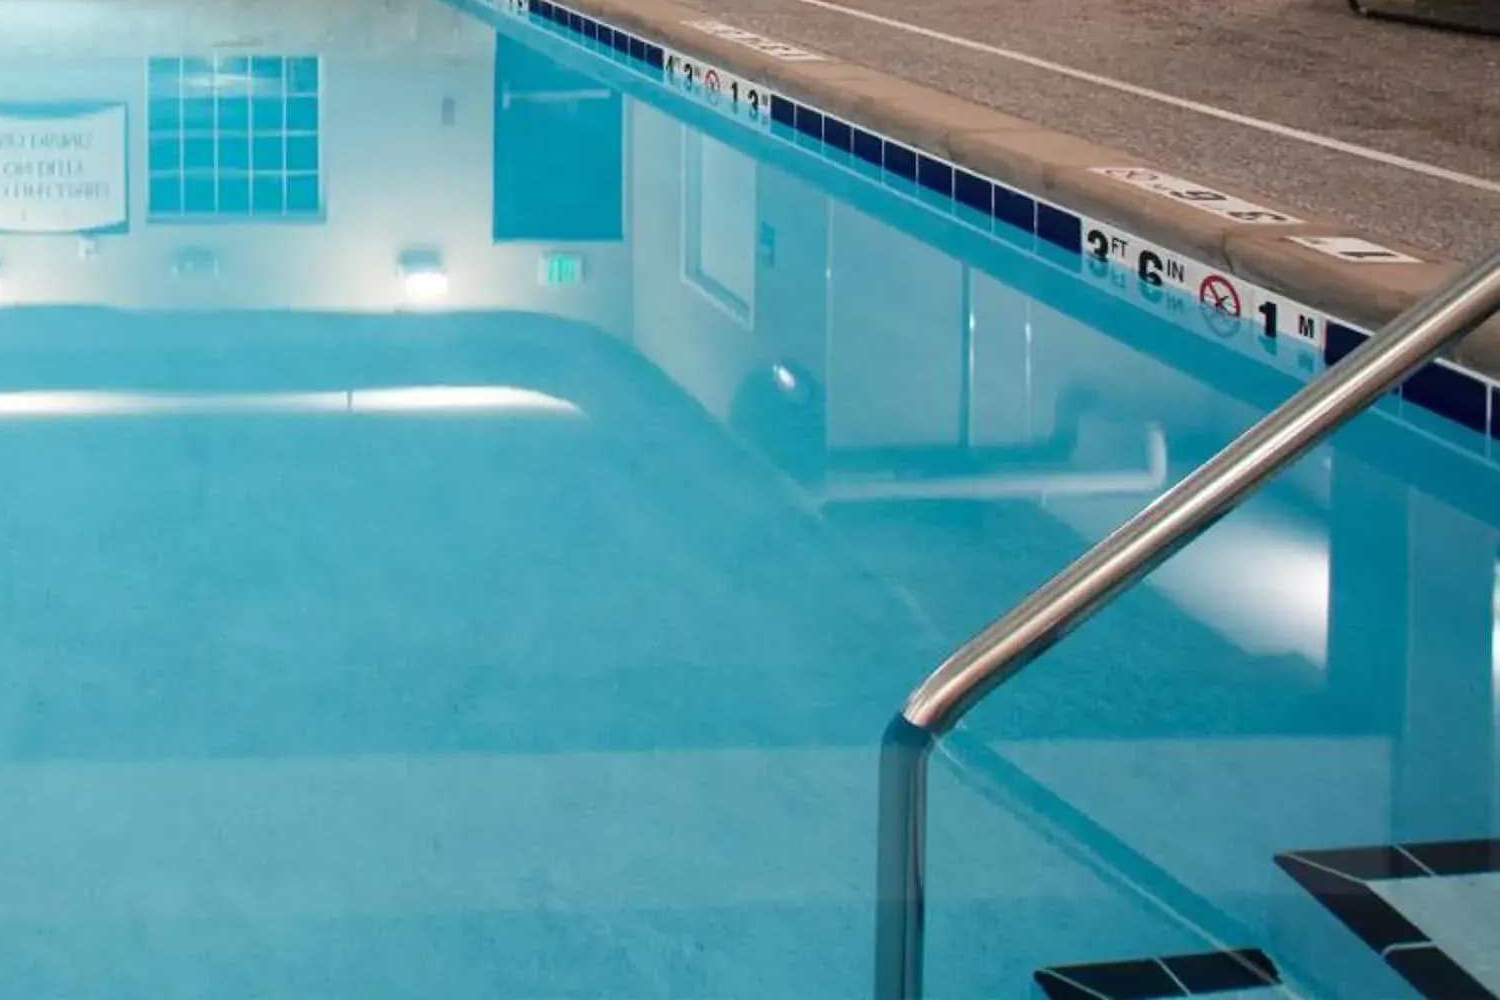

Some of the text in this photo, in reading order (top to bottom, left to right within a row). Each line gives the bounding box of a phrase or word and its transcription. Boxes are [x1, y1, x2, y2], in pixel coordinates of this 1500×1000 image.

[1087, 229, 1109, 263] 3
[1111, 237, 1129, 258] FT
[1138, 250, 1164, 286] 6
[1166, 259, 1185, 283] IN
[1258, 301, 1277, 339] 1
